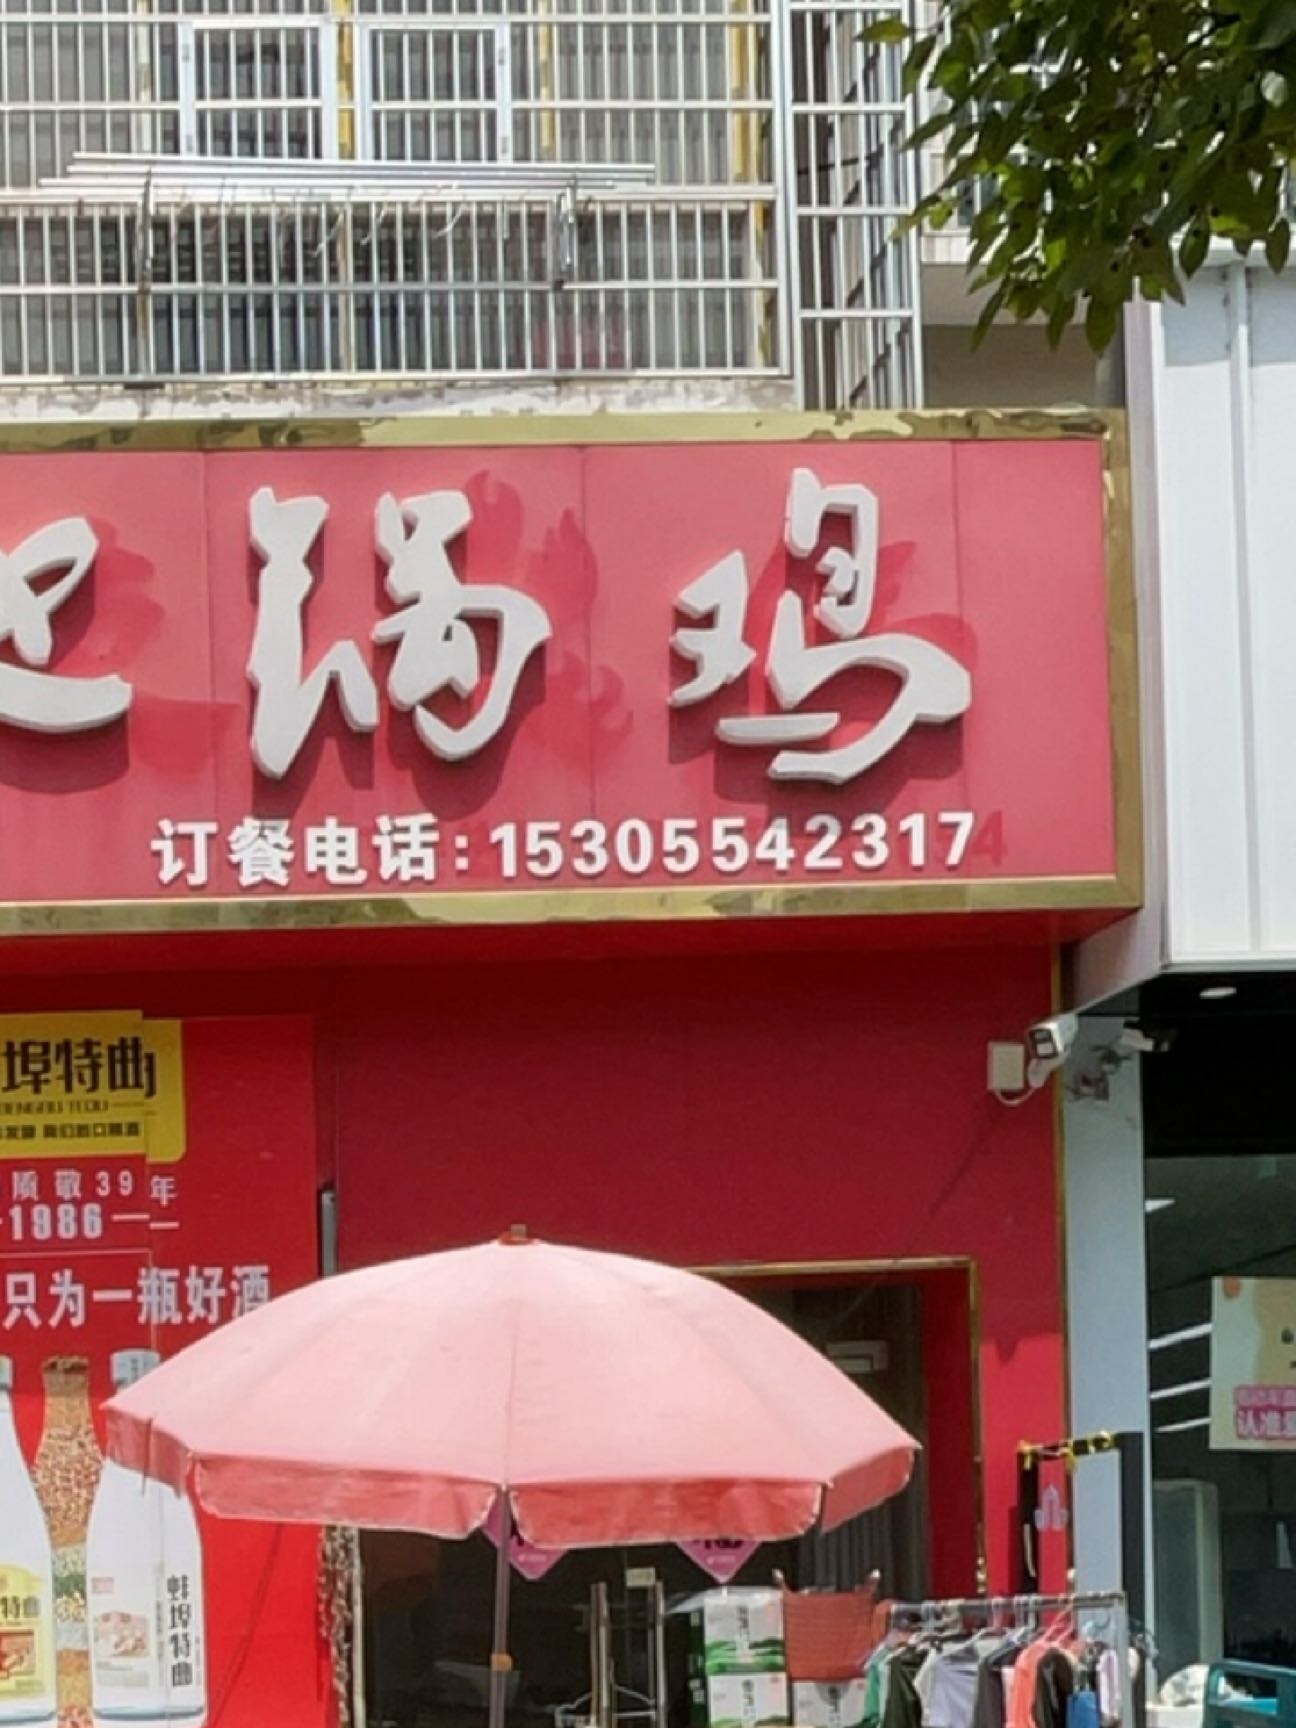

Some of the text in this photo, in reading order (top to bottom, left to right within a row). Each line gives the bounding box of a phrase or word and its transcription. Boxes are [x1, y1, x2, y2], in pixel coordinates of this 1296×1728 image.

[8, 1203, 103, 1240] 1986
[2, 1264, 272, 1330] 只为一瓶好酒
